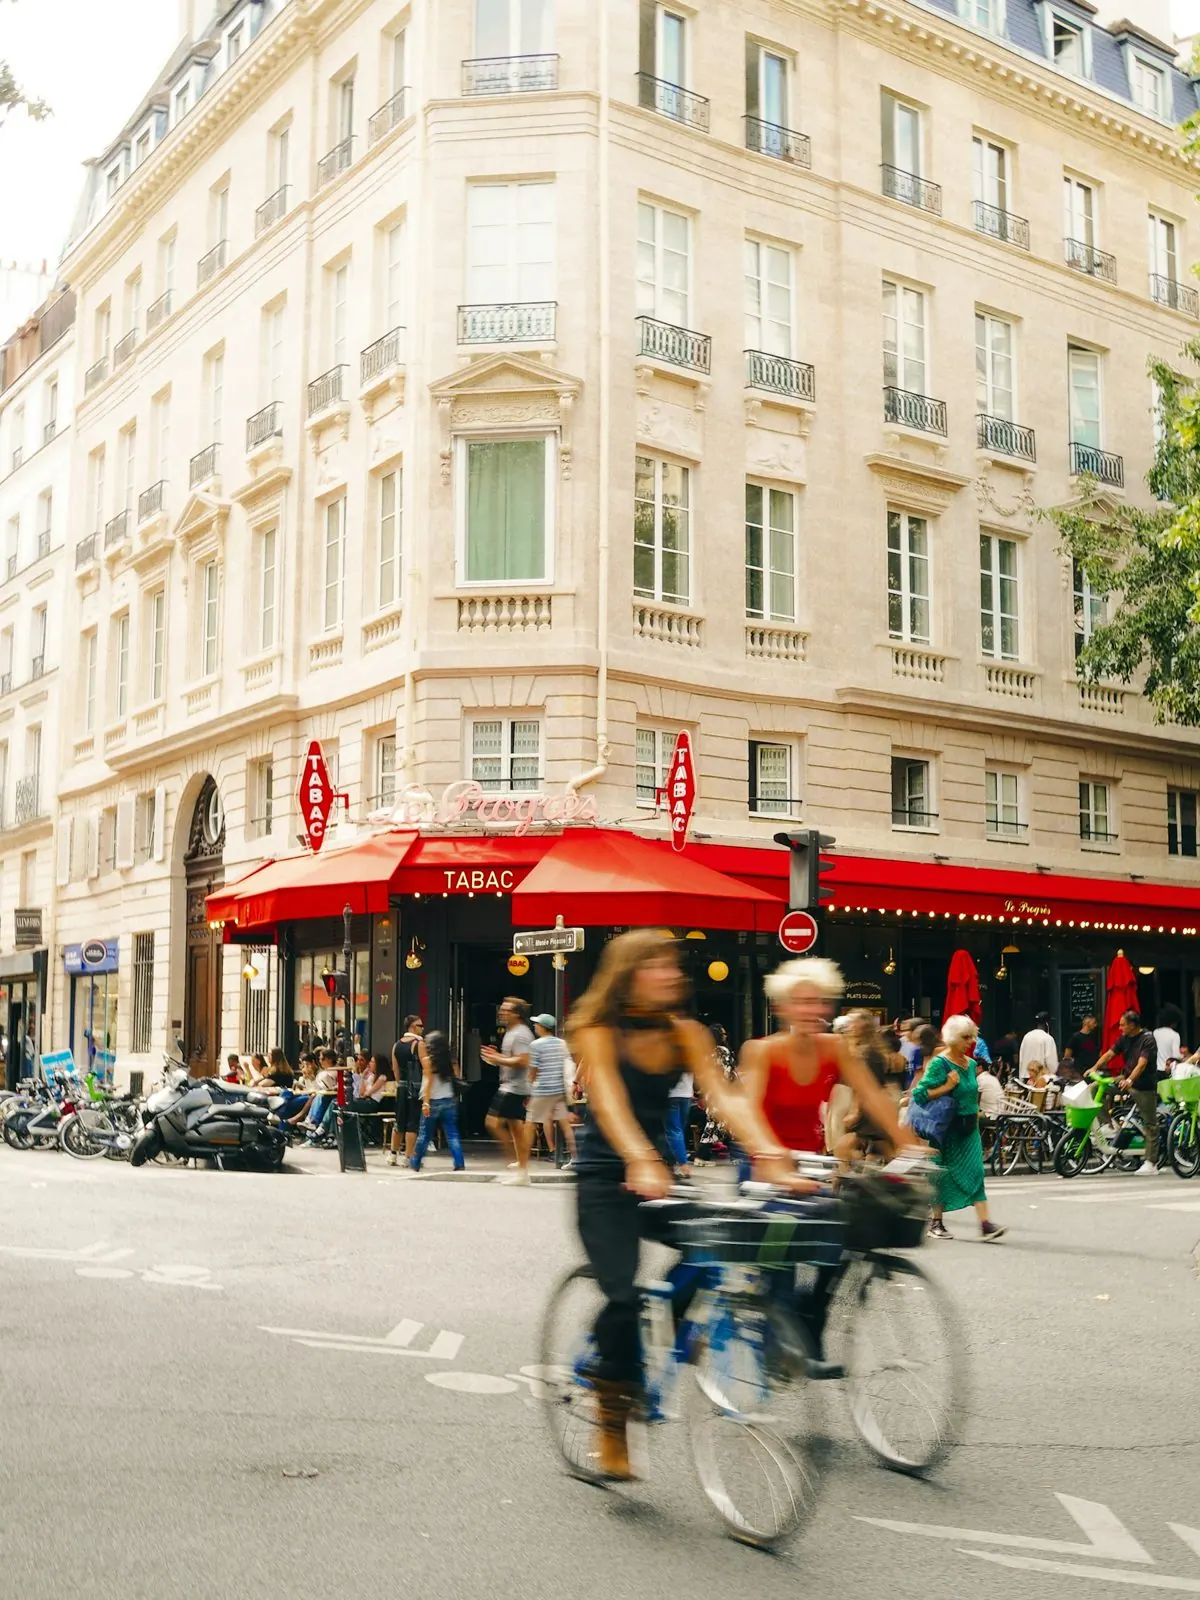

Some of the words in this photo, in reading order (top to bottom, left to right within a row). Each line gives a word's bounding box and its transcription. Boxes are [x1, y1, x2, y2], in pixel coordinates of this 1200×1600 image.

[307, 754, 324, 837] TABAC
[672, 747, 688, 832] TABAC
[443, 870, 513, 889] TABAC
[1004, 899, 1016, 912] Le
[1018, 901, 1051, 916] Progrès
